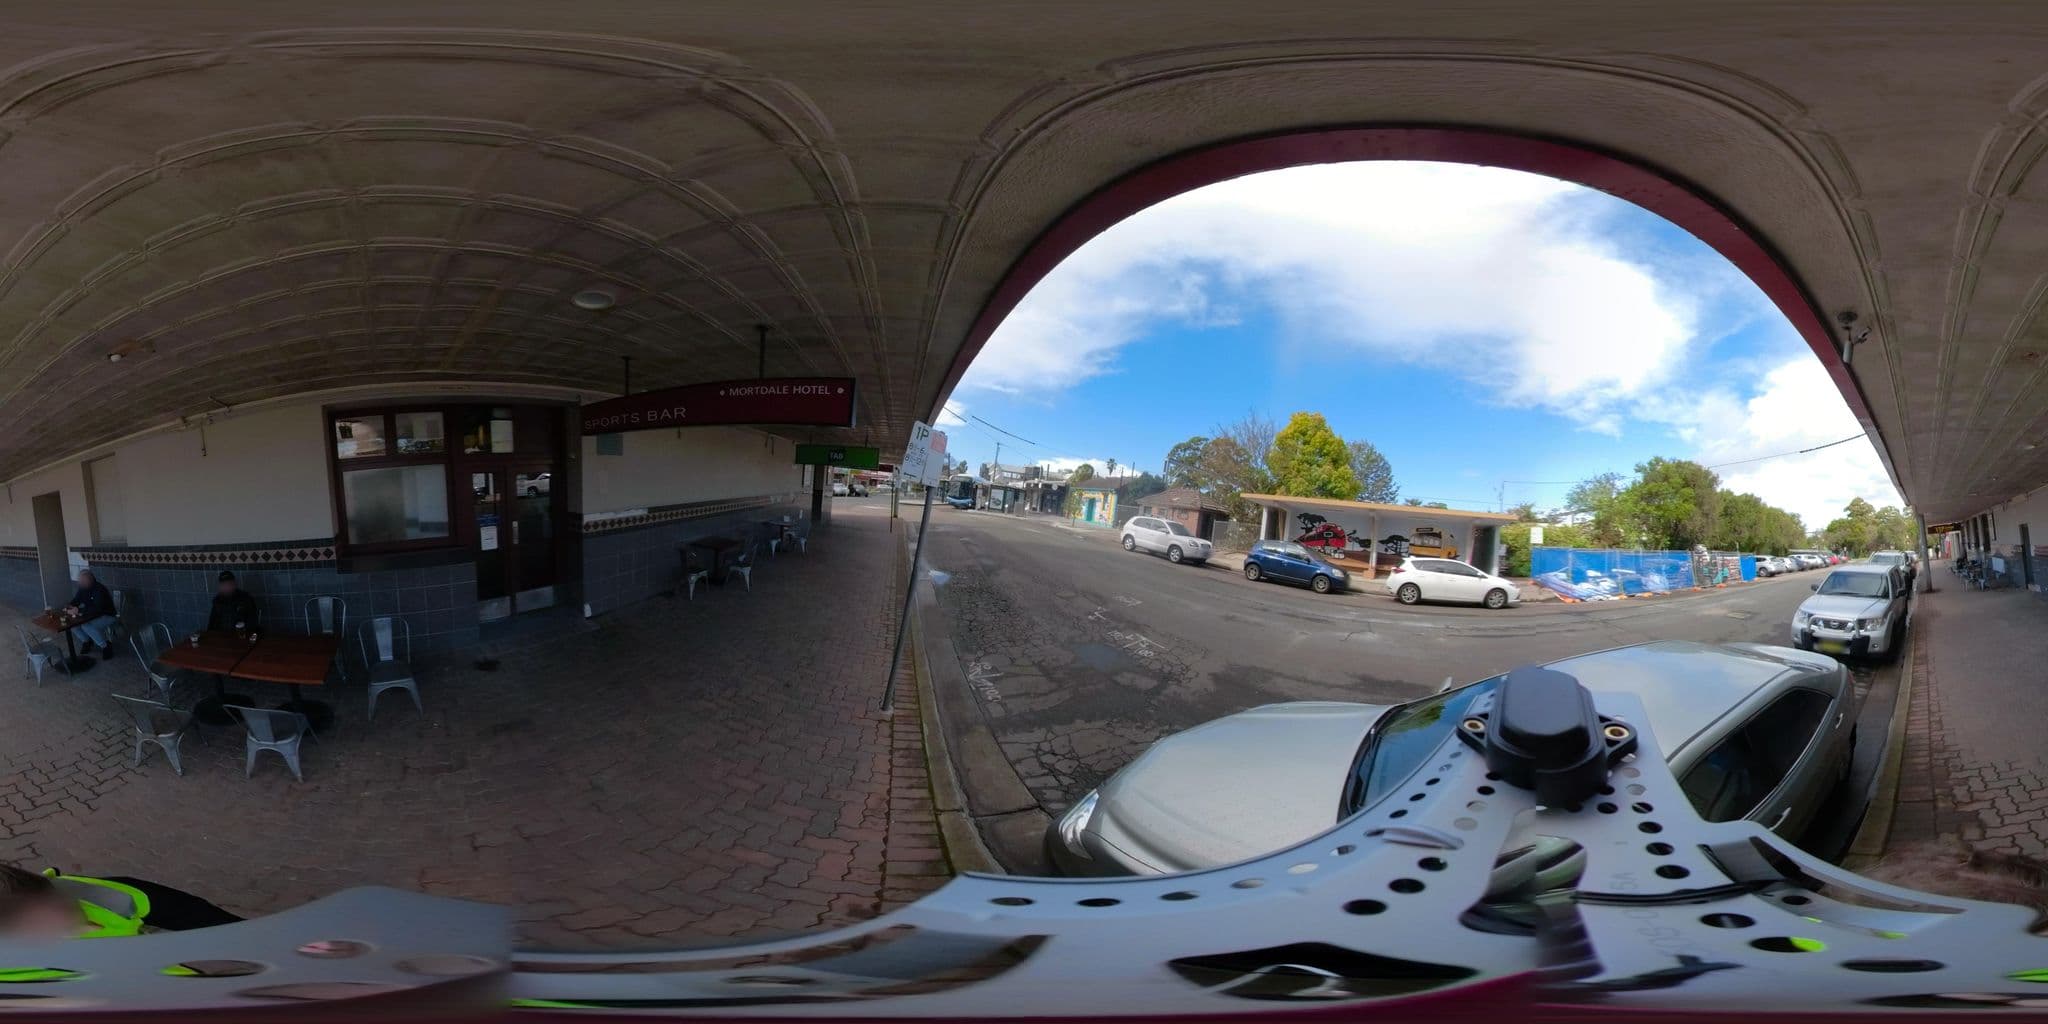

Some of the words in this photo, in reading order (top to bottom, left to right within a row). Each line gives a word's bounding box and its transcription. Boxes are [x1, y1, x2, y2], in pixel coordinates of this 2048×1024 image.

[729, 385, 788, 396] MORTDALE
[792, 385, 830, 395] HOTEL
[585, 413, 641, 430] SPORTS
[647, 407, 687, 422] BAR
[916, 427, 929, 440] 1P
